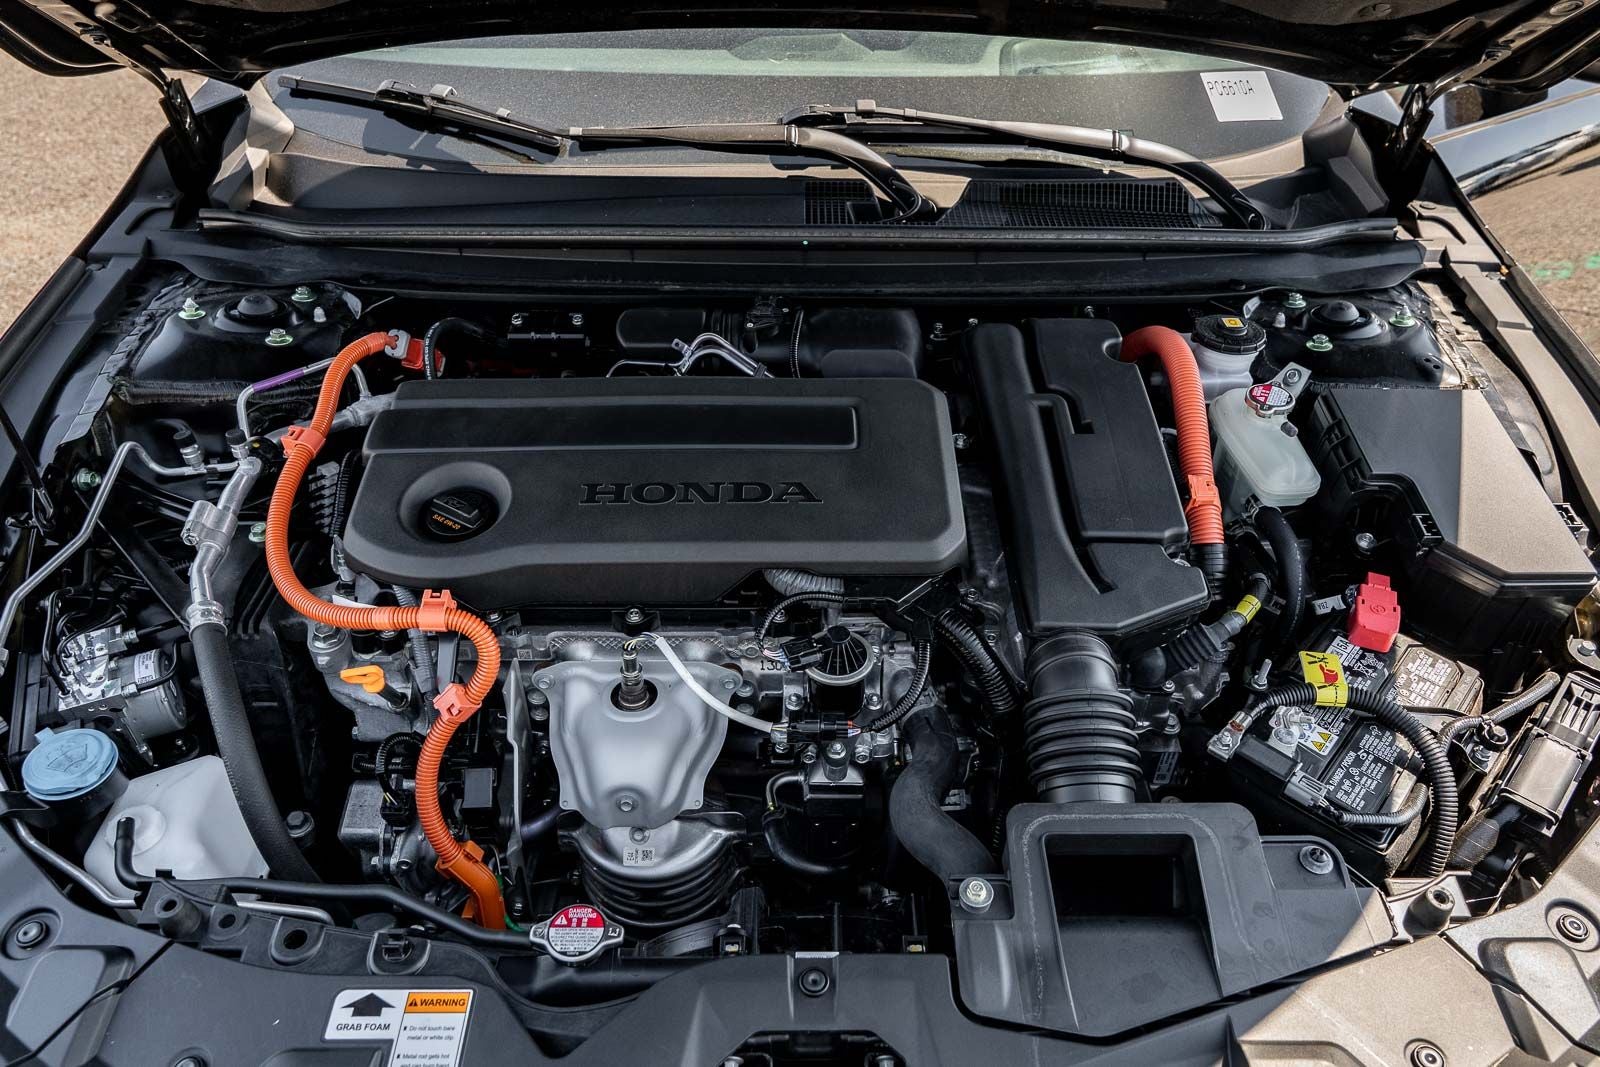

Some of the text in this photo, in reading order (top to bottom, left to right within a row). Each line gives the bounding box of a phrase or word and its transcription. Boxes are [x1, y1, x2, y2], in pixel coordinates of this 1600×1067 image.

[578, 481, 824, 505] HONDA
[420, 998, 466, 1007] WARNING
[336, 1023, 391, 1031] GRAB FOAM
